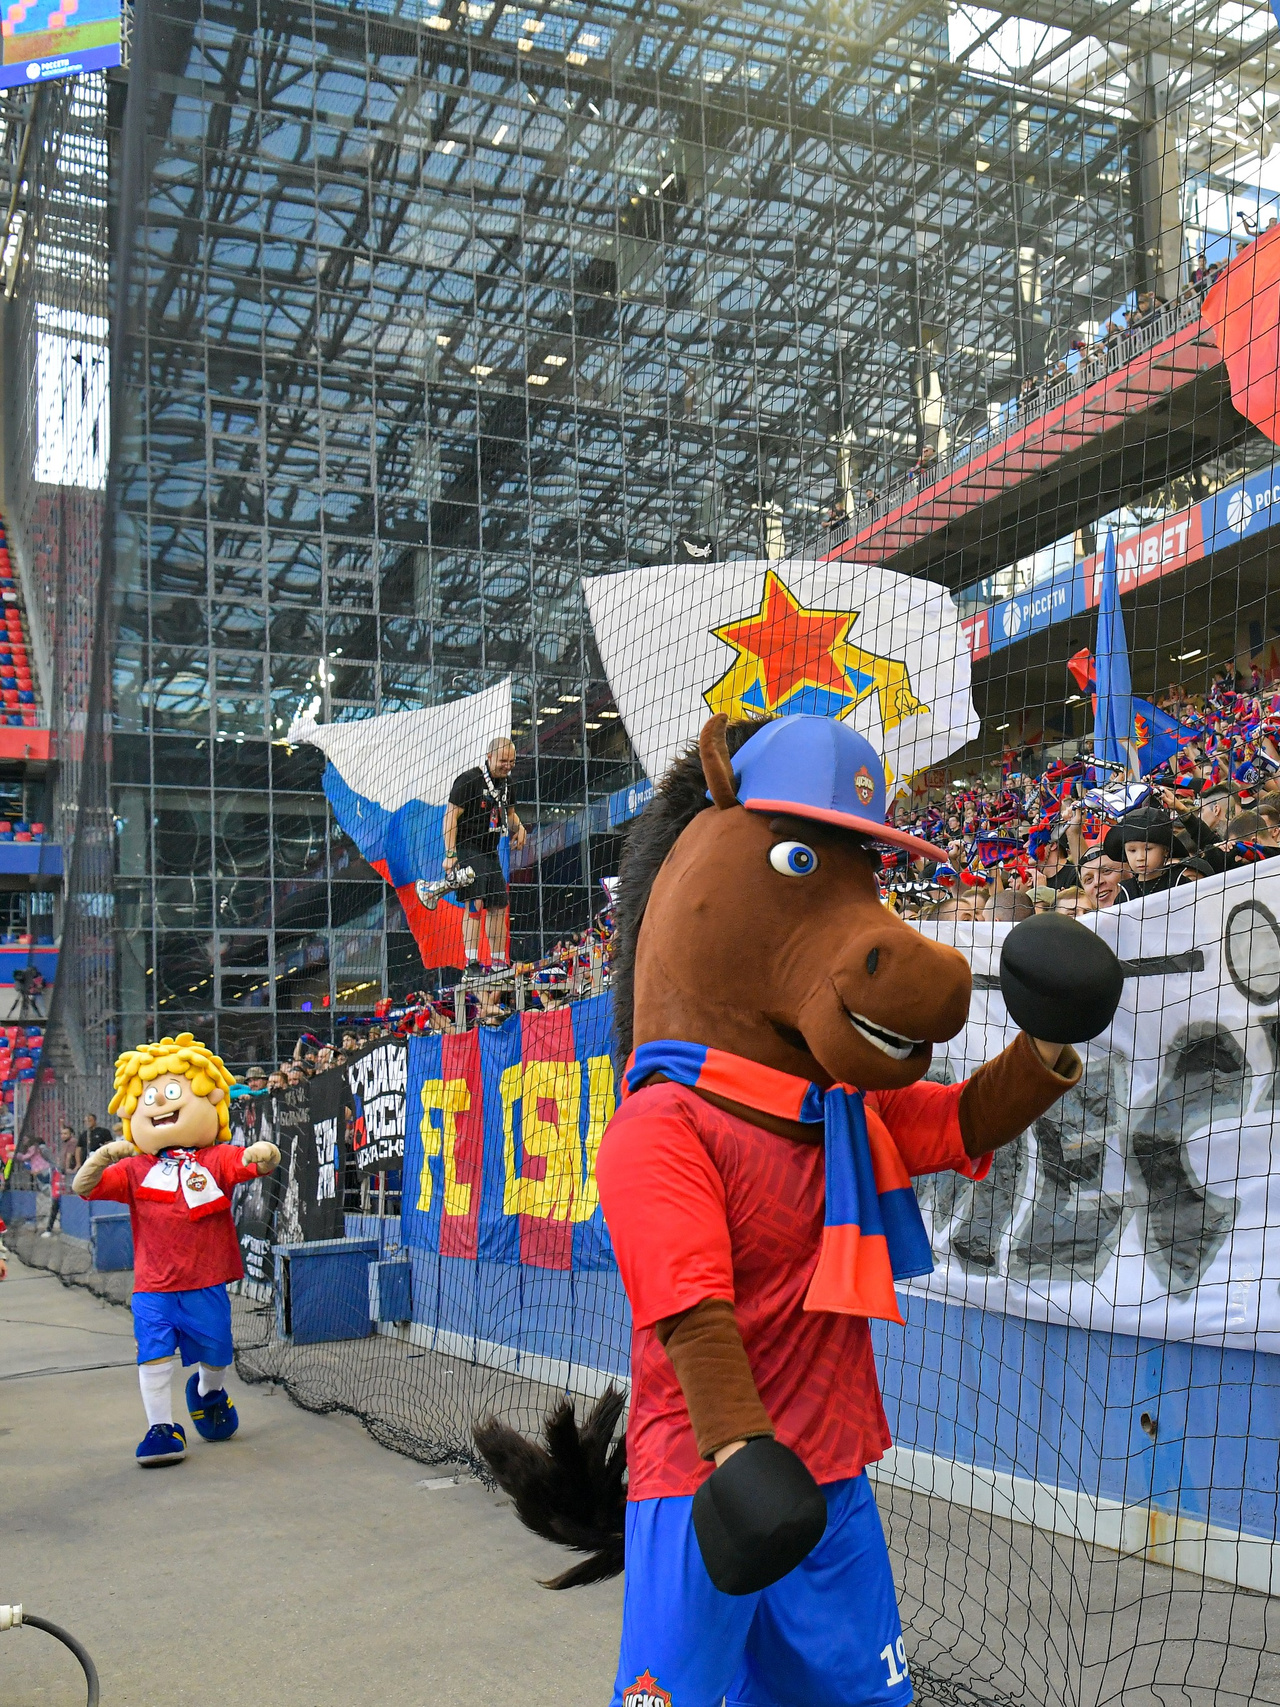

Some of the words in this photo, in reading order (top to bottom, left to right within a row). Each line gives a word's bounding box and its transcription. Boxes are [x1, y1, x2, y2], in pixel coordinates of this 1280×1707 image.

[1023, 587, 1066, 622] РОССЕТИ
[416, 1077, 472, 1217] FC
[880, 1634, 909, 1688] 19
